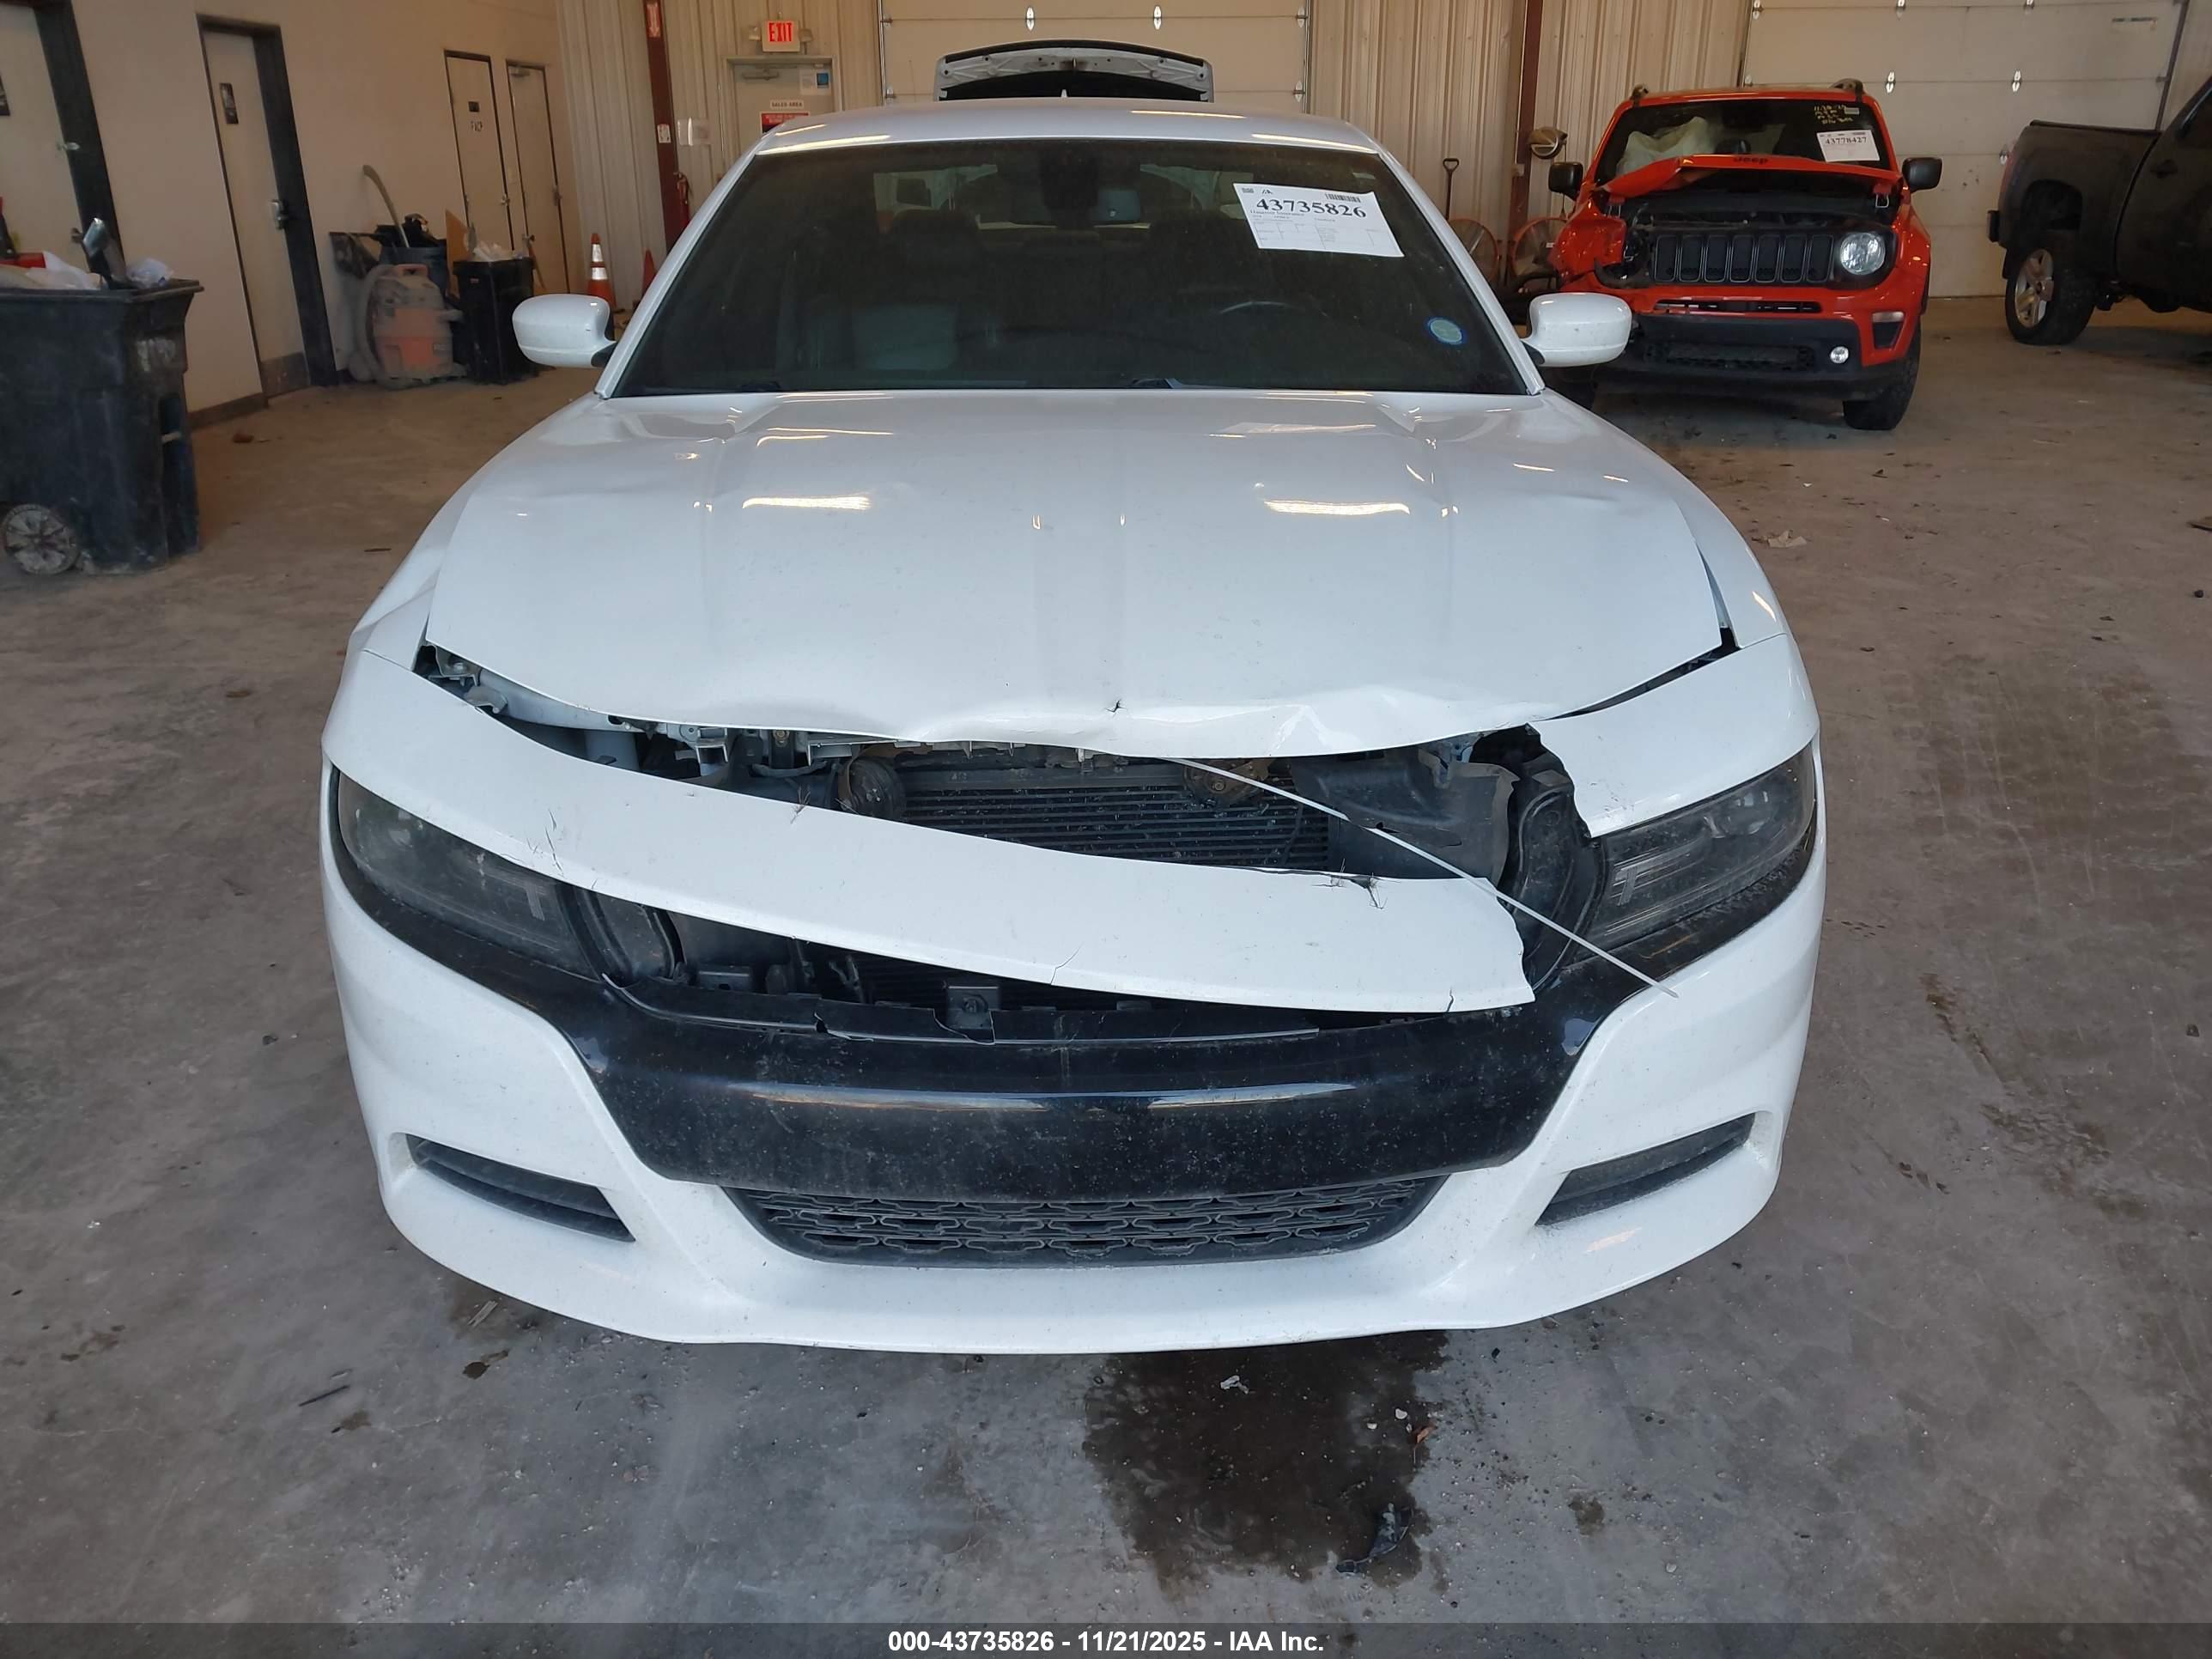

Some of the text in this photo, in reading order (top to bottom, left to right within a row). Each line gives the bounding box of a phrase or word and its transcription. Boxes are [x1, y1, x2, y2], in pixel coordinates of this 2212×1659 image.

[769, 22, 793, 42] EXIT
[1826, 137, 1867, 145] 43778427
[1256, 198, 1367, 218] 43735826
